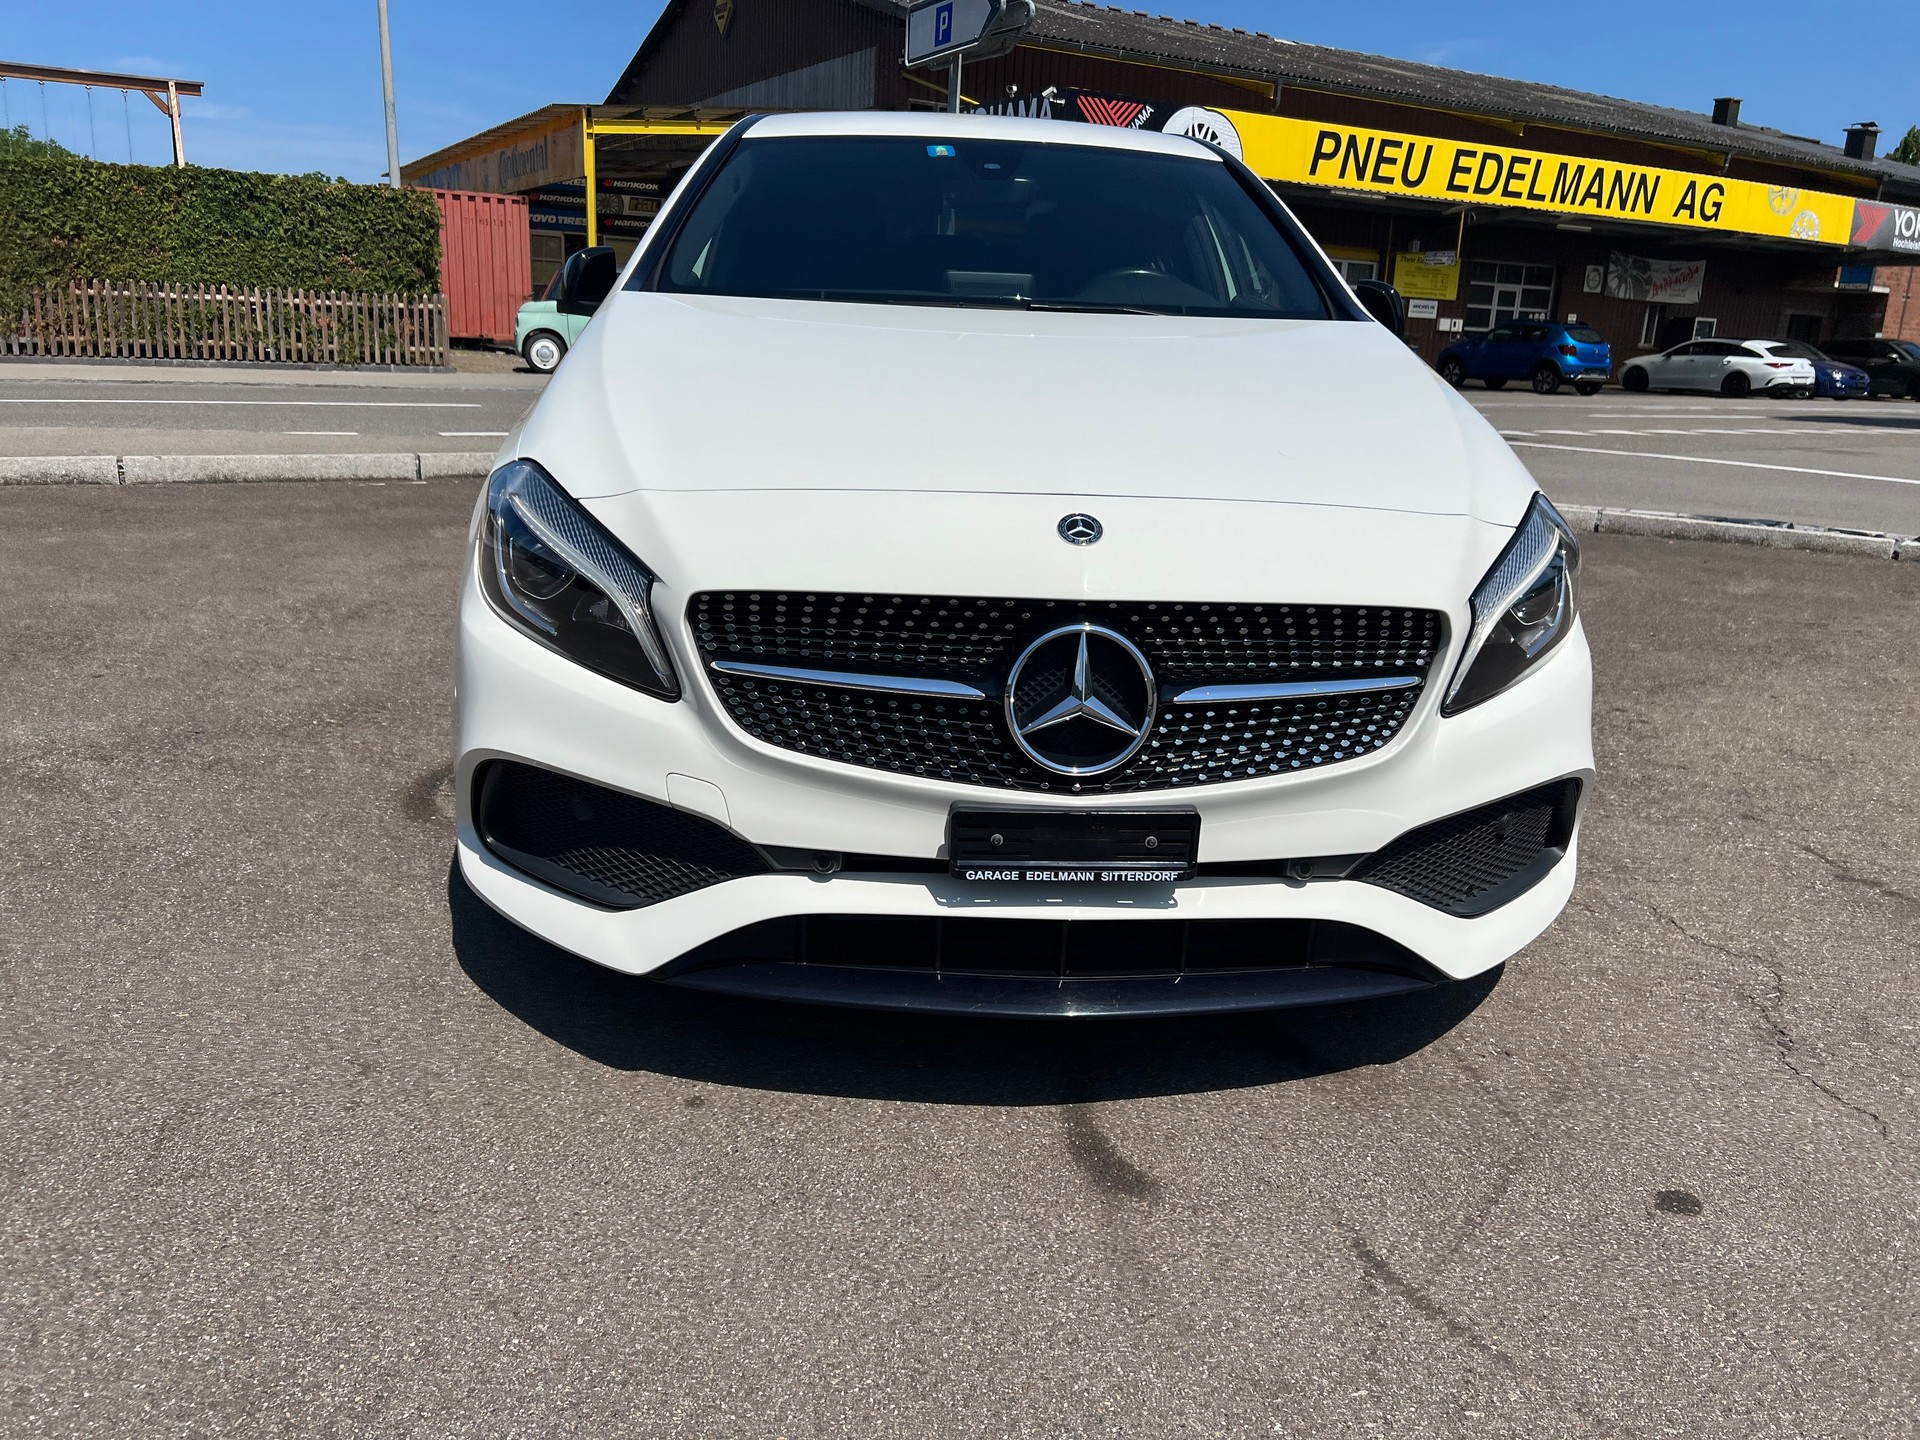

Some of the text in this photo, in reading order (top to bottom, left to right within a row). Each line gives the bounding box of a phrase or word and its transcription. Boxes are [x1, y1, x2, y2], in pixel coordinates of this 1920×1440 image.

[940, 10, 949, 41] P
[1128, 105, 1155, 130] HAMA
[1309, 129, 1726, 223] PNEU EDELMANN AG
[965, 870, 1179, 882] GARAGE EDELMANN SITTERDORF
